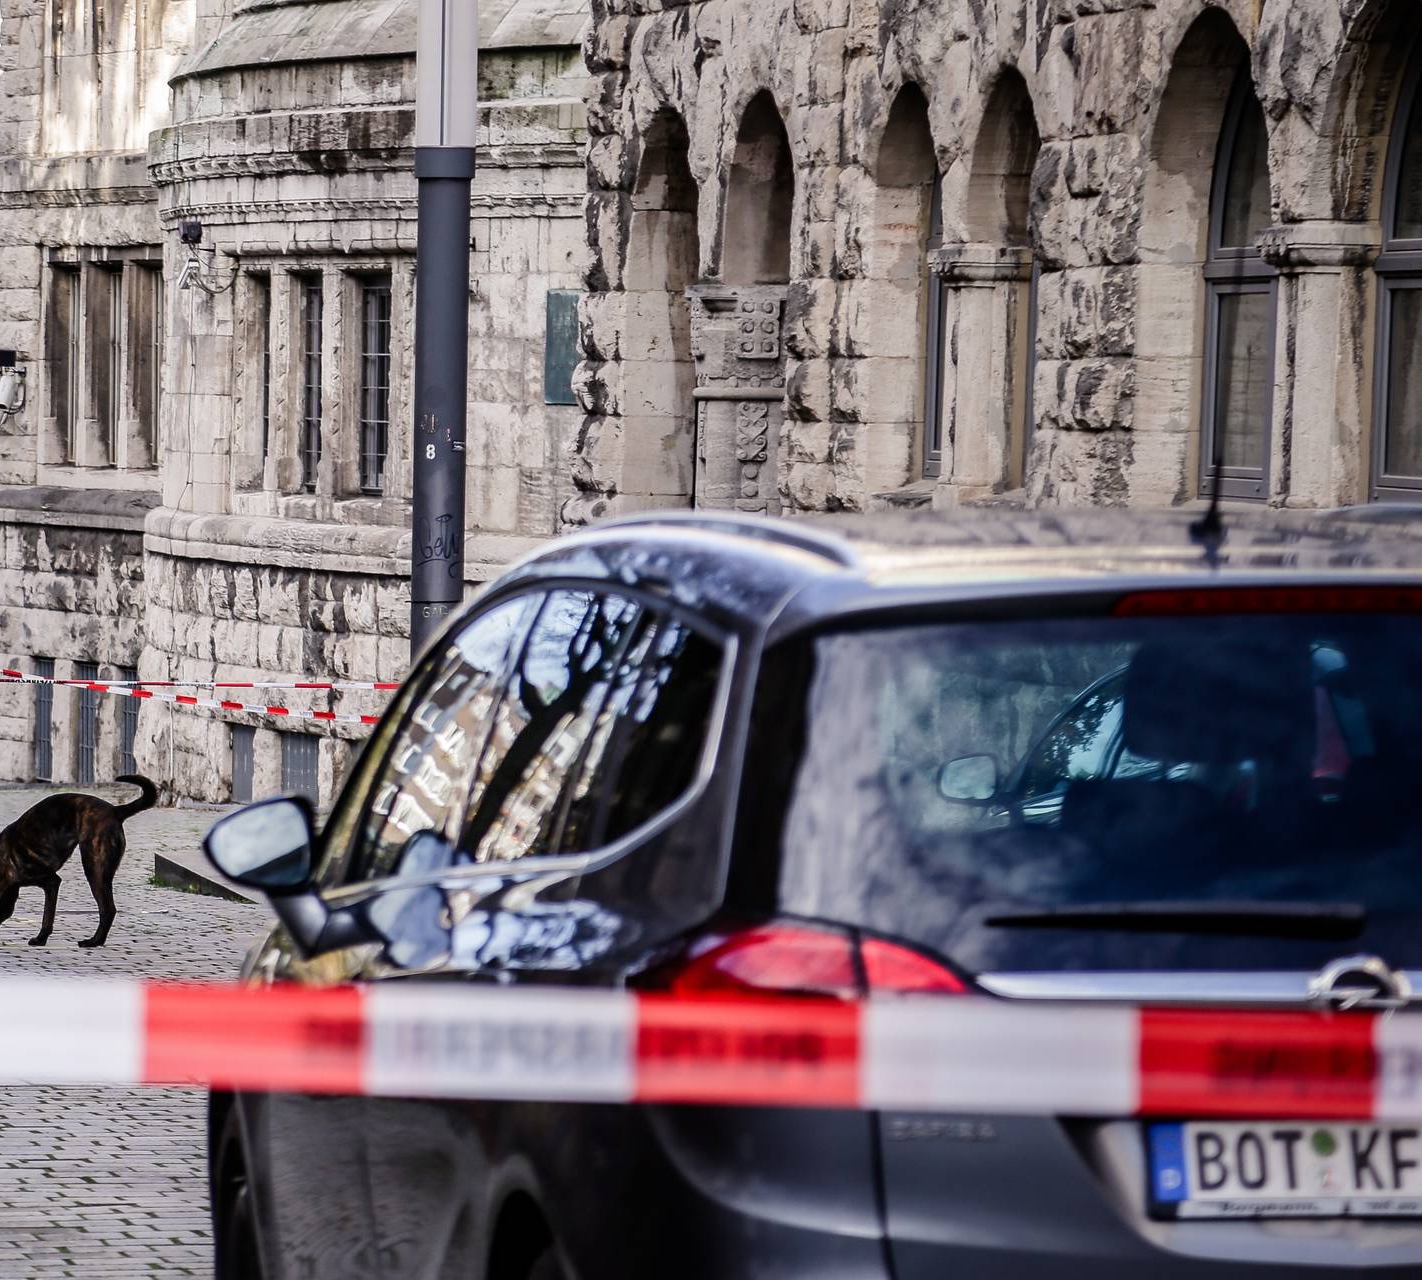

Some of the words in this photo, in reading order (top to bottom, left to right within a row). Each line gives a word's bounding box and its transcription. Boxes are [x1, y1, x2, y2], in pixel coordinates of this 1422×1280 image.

[426, 443, 436, 460] 8
[1195, 1129, 1304, 1191] BOT
[1350, 1128, 1419, 1191] KF
